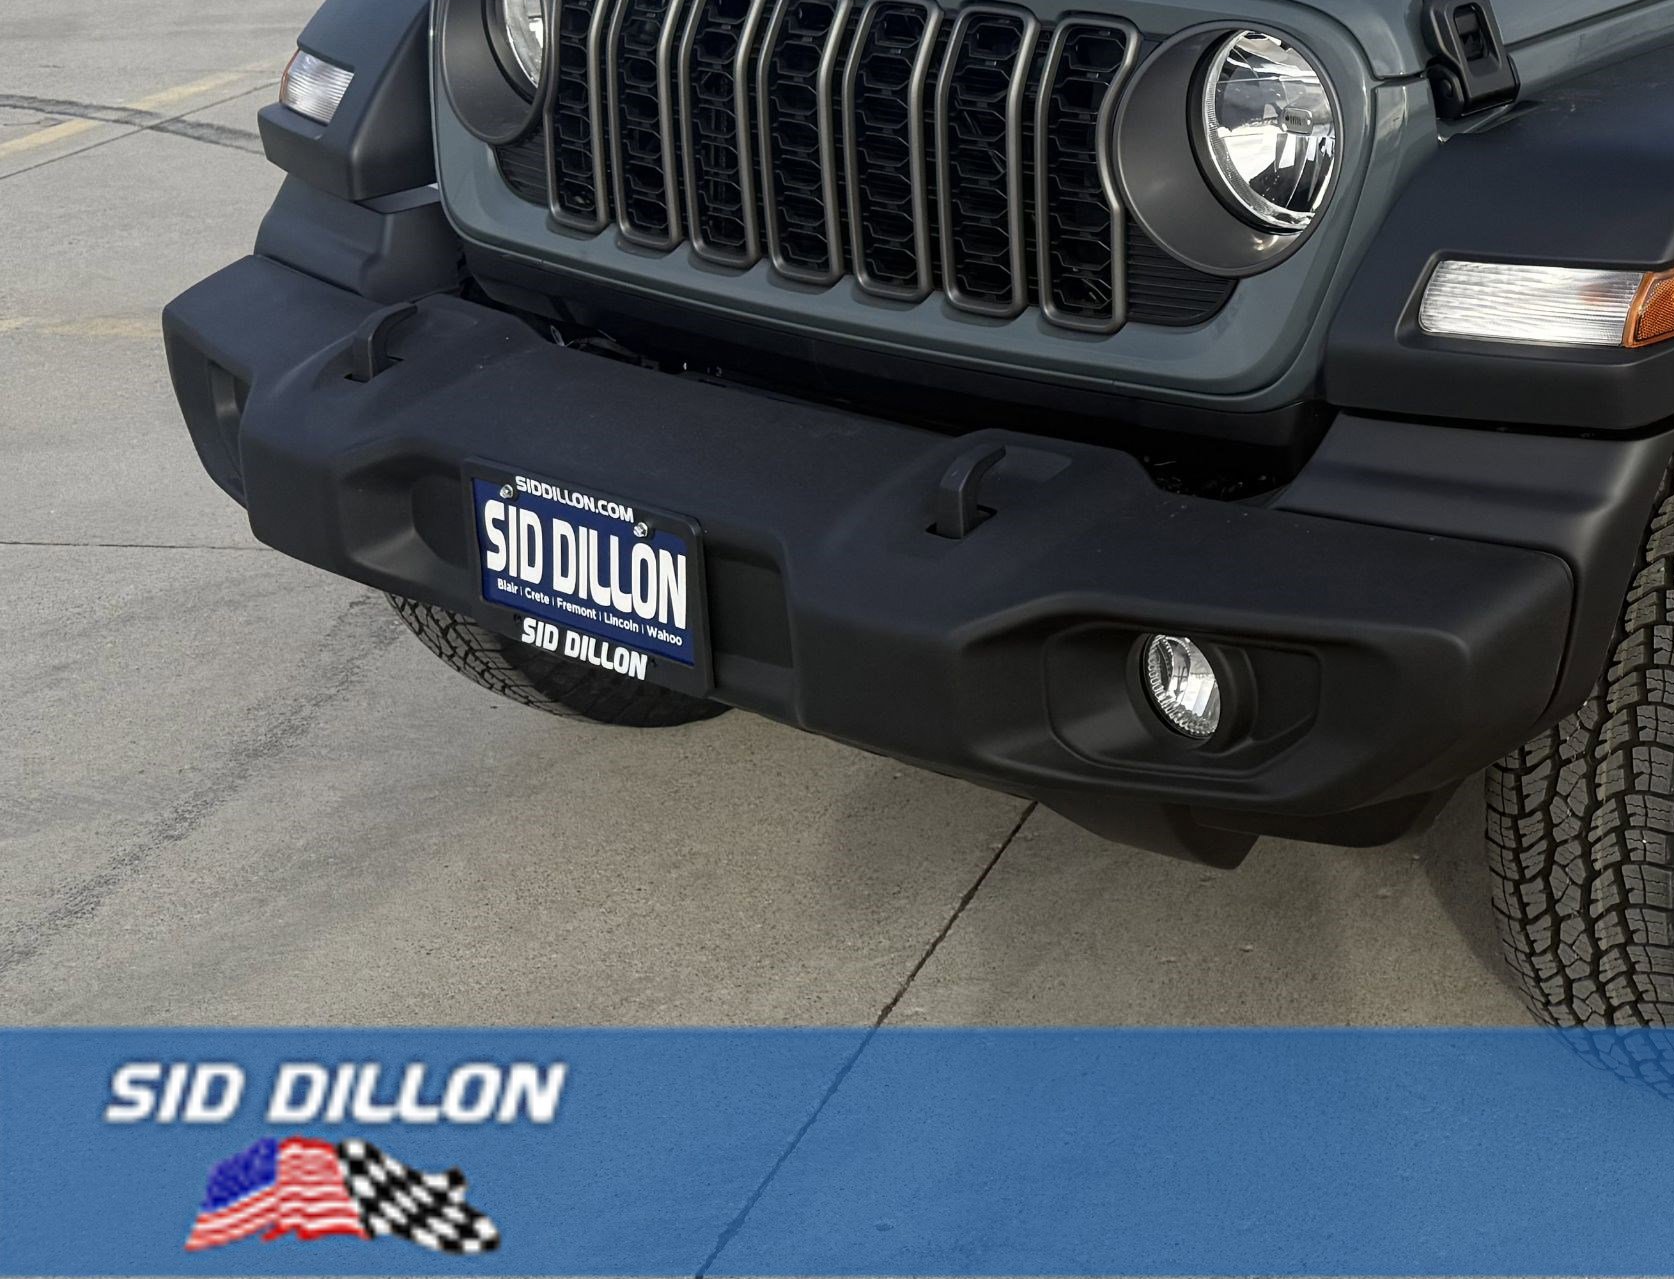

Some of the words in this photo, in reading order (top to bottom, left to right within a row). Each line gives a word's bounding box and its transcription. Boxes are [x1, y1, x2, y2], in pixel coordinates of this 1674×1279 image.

[515, 475, 635, 523] SIDDILLON.COM
[484, 498, 544, 585] SID
[552, 517, 687, 630] DILLON
[497, 578, 519, 595] Blair
[524, 587, 550, 606] Crete
[556, 597, 597, 621] Fremont
[603, 611, 639, 634] Lincoln
[647, 626, 683, 647] Wahoo
[521, 617, 559, 653] SID
[563, 629, 648, 681] DILLON
